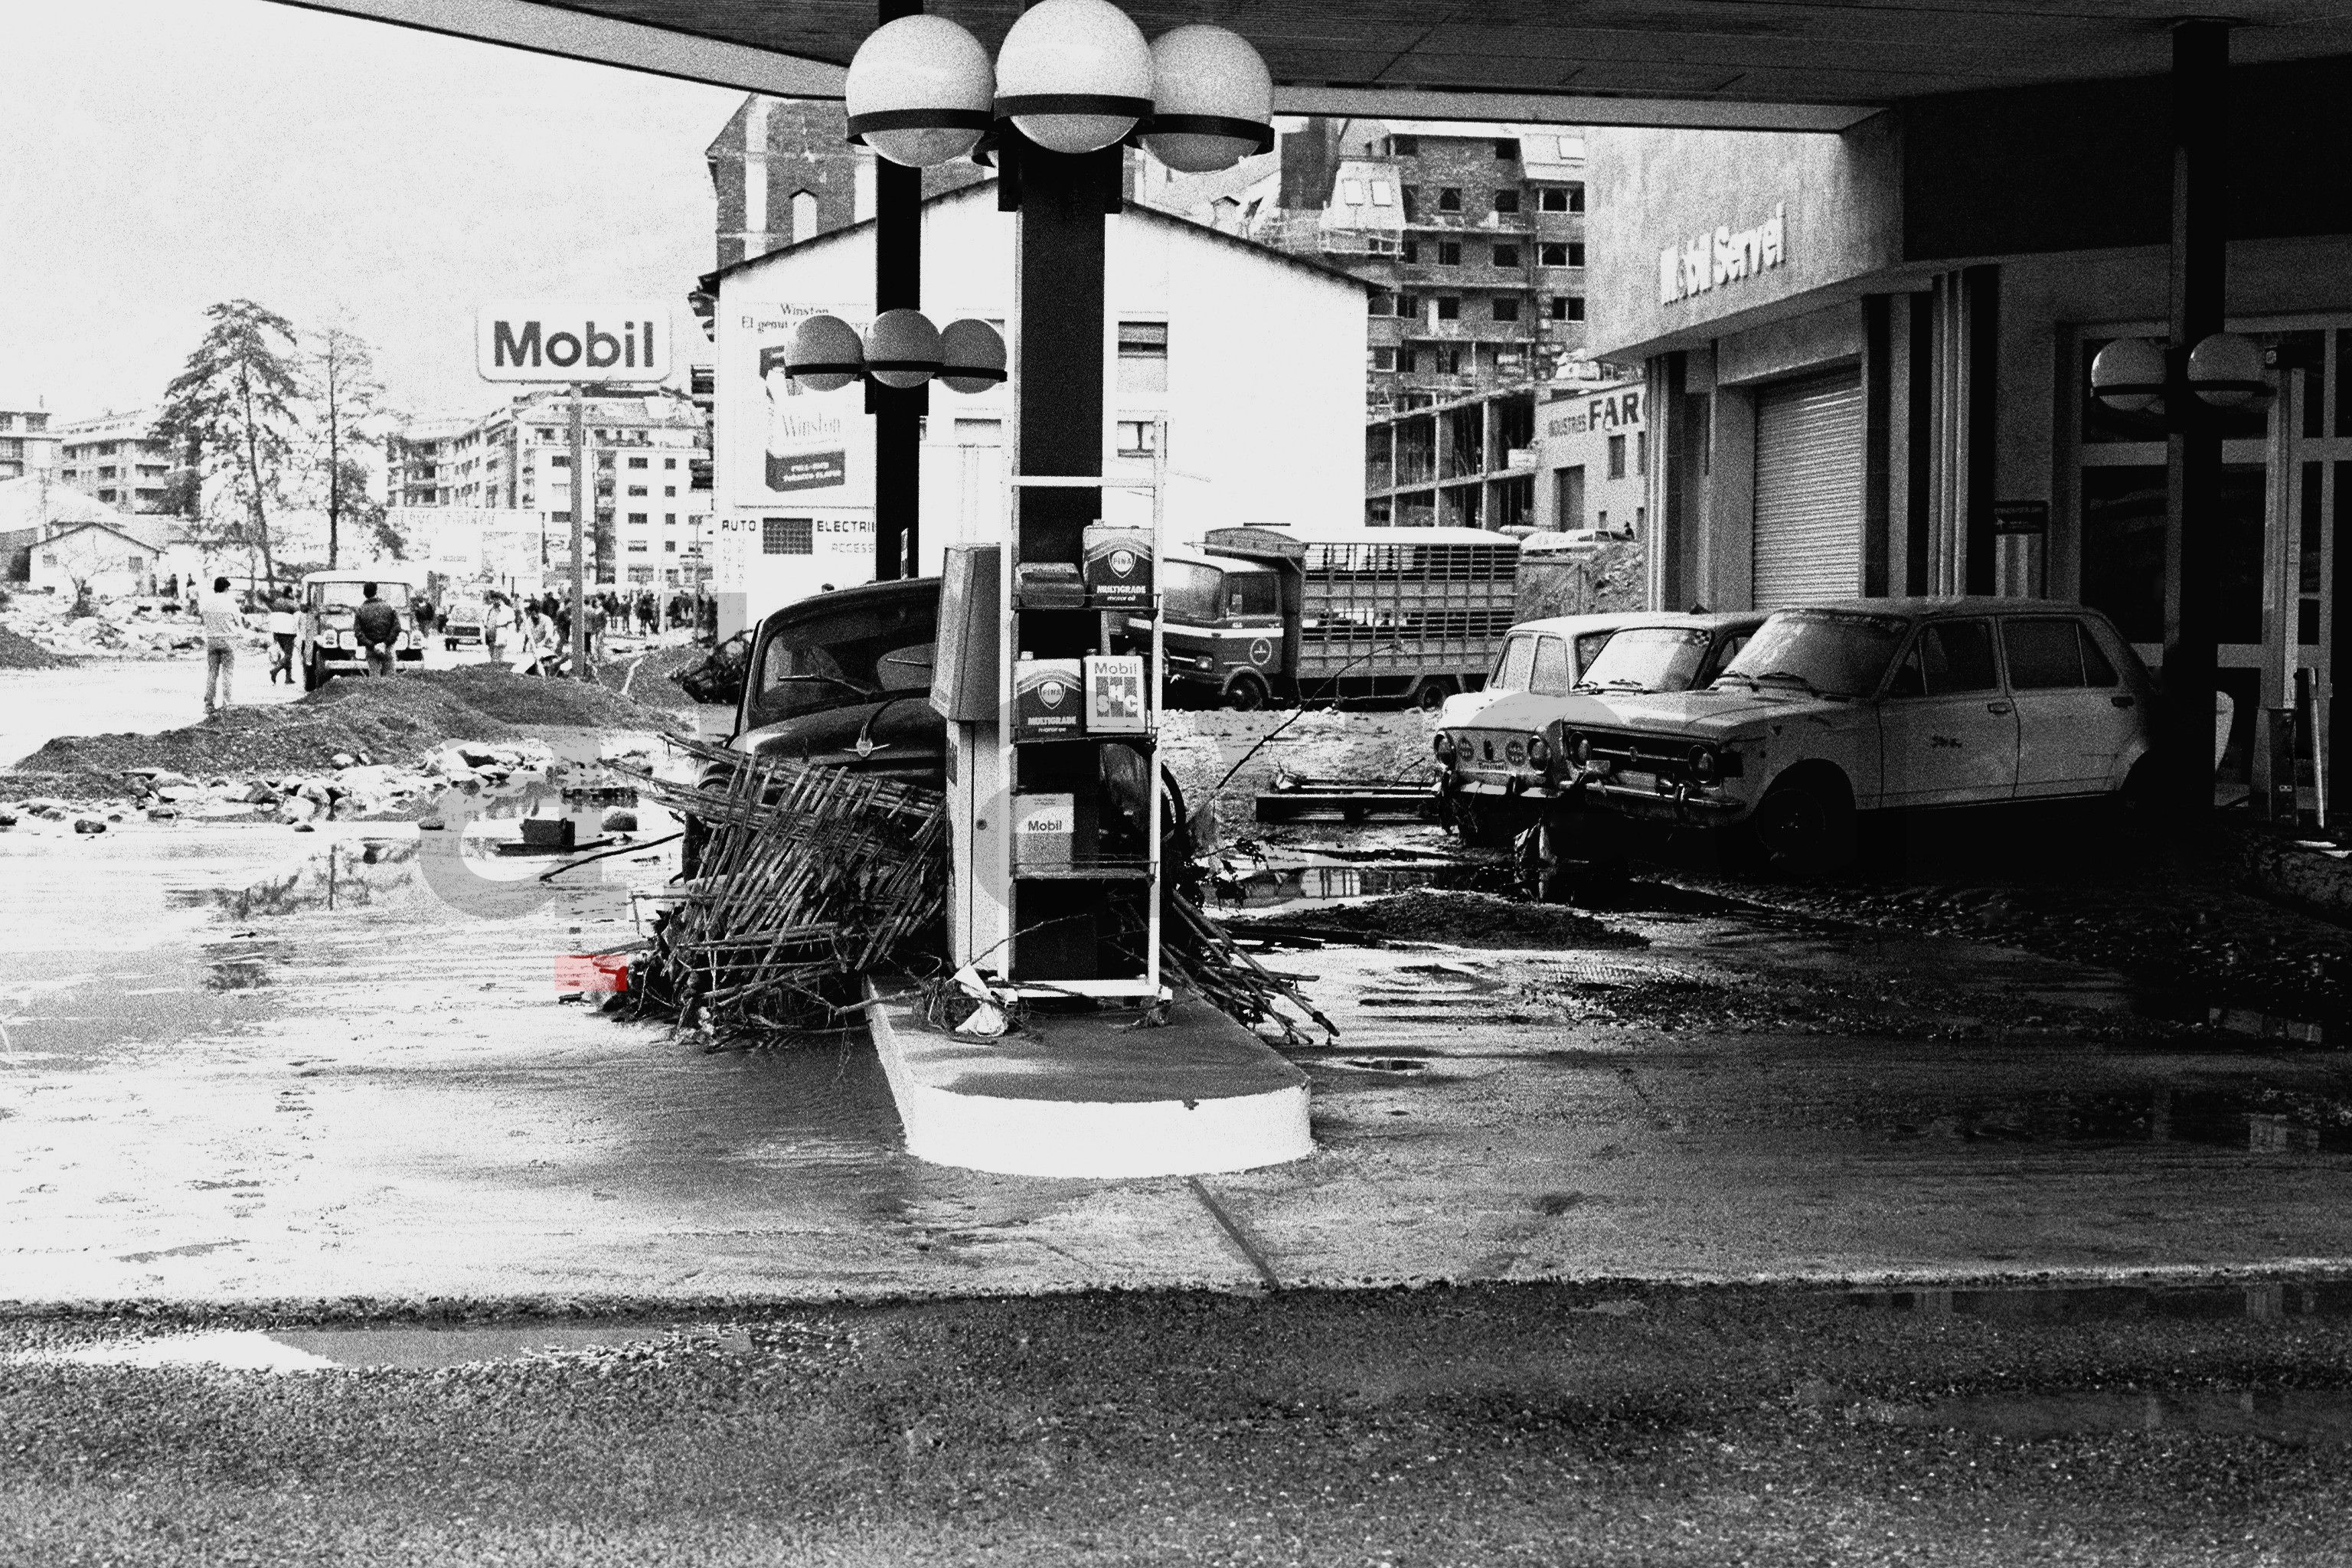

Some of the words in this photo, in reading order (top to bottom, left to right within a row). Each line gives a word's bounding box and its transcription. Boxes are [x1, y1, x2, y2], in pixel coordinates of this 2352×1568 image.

[493, 320, 655, 368] Mobil
[1589, 392, 1647, 432] FAR
[782, 412, 841, 437] Winston
[721, 520, 756, 532] AUTO
[1096, 585, 1147, 594] MULTIGRADE
[1094, 662, 1138, 675] Mobil
[1027, 820, 1063, 831] Mobil
